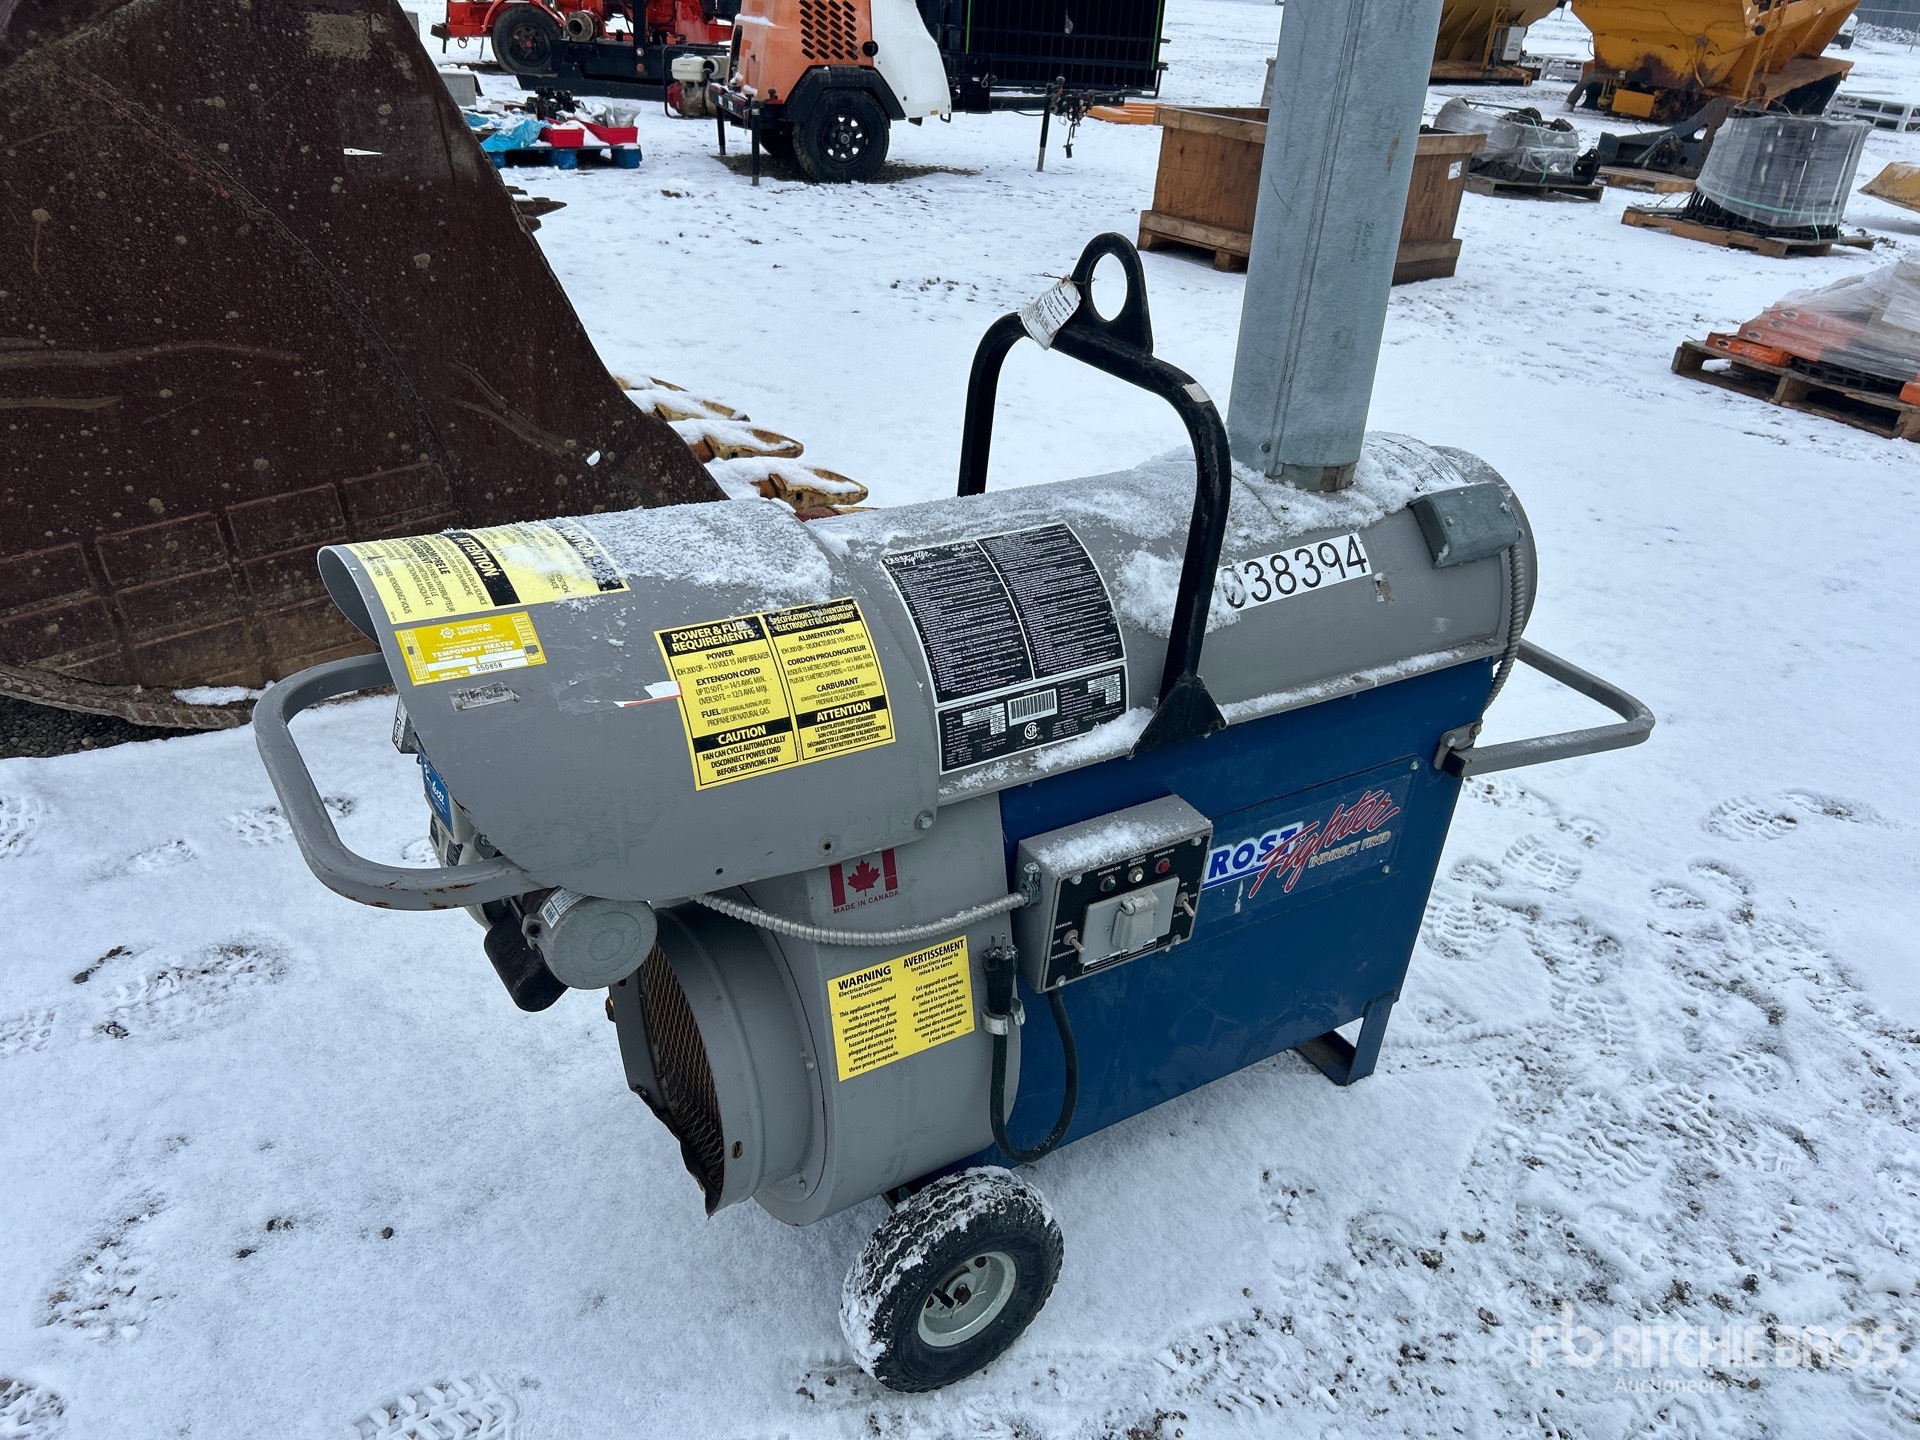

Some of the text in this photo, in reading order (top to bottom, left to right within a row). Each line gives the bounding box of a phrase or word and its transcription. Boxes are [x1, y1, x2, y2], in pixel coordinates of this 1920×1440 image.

[455, 537, 499, 576] ATTENTION
[438, 567, 451, 575] LE
[426, 581, 436, 592] MAIS
[474, 588, 488, 605] SOURCE
[401, 601, 412, 614] VOUS
[456, 622, 491, 632] TECHNICAL
[808, 618, 815, 626] ET
[671, 628, 713, 642] POWER
[712, 626, 722, 635] &
[672, 629, 755, 652] REQUIREMENTS
[798, 628, 845, 642] ALIMENTATION
[432, 640, 516, 658] TEMPORARY HEATER
[706, 649, 735, 660] POWER
[787, 645, 867, 666] CORDON PROLONGATEUR
[476, 662, 503, 671] 550858
[686, 666, 696, 674] 200
[716, 659, 729, 668] VOLT
[748, 651, 770, 662] BREAKER
[696, 667, 761, 686] EXTENSION CORD
[816, 677, 858, 692] CARBURANT
[695, 688, 703, 696] UP
[710, 685, 717, 693] 50
[729, 681, 741, 689] 14/3
[741, 678, 753, 686] AWG
[699, 696, 714, 705] OVER
[731, 690, 743, 698] 12/3
[743, 687, 755, 696] AWG
[701, 708, 721, 718] FUEL
[707, 715, 730, 727] PROPANE
[737, 709, 760, 720] NATURAL
[759, 707, 770, 715] GAS
[817, 701, 871, 722] ATTENTION
[717, 725, 766, 744] CAUTION
[702, 735, 786, 761] FAN CAN CYCLE AUTOMATICALLY
[711, 746, 781, 769] DISCONNECT POWER CORD
[716, 755, 779, 777] BEFORE SERVICING FAN
[1208, 789, 1400, 898] ROST Fighter
[1308, 830, 1392, 869] INDIRECT FIRED
[1128, 859, 1146, 867] BREAKER
[1130, 855, 1146, 863] CIRCUIT
[1153, 850, 1169, 859] POWER
[1097, 867, 1114, 877] BURNER
[833, 903, 856, 914] MADE
[868, 890, 899, 904] CANADA
[1055, 921, 1073, 929] MANUAL
[904, 939, 964, 969] AVERTISSEMENT
[911, 959, 941, 972] Instructions
[941, 954, 953, 963] pour
[1050, 948, 1076, 960] THERMOSTAT
[838, 965, 891, 990] WARNING
[923, 978, 940, 989] appareil
[839, 976, 893, 998] Electrical Grounding
[850, 986, 883, 1000] Instructions
[849, 1004, 871, 1015] appliance
[876, 993, 896, 1005] equipped
[848, 1015, 859, 1023] with
[870, 1017, 880, 1025] plug
[887, 1011, 897, 1019] your
[932, 1013, 957, 1026] directement
[946, 1019, 962, 1028] courant
[844, 1018, 897, 1043] protection against shock
[848, 1038, 864, 1048] hazard
[874, 1029, 888, 1039] should
[848, 1045, 867, 1058] plugged
[867, 1040, 884, 1049] directly
[853, 1043, 894, 1064] properly grounded
